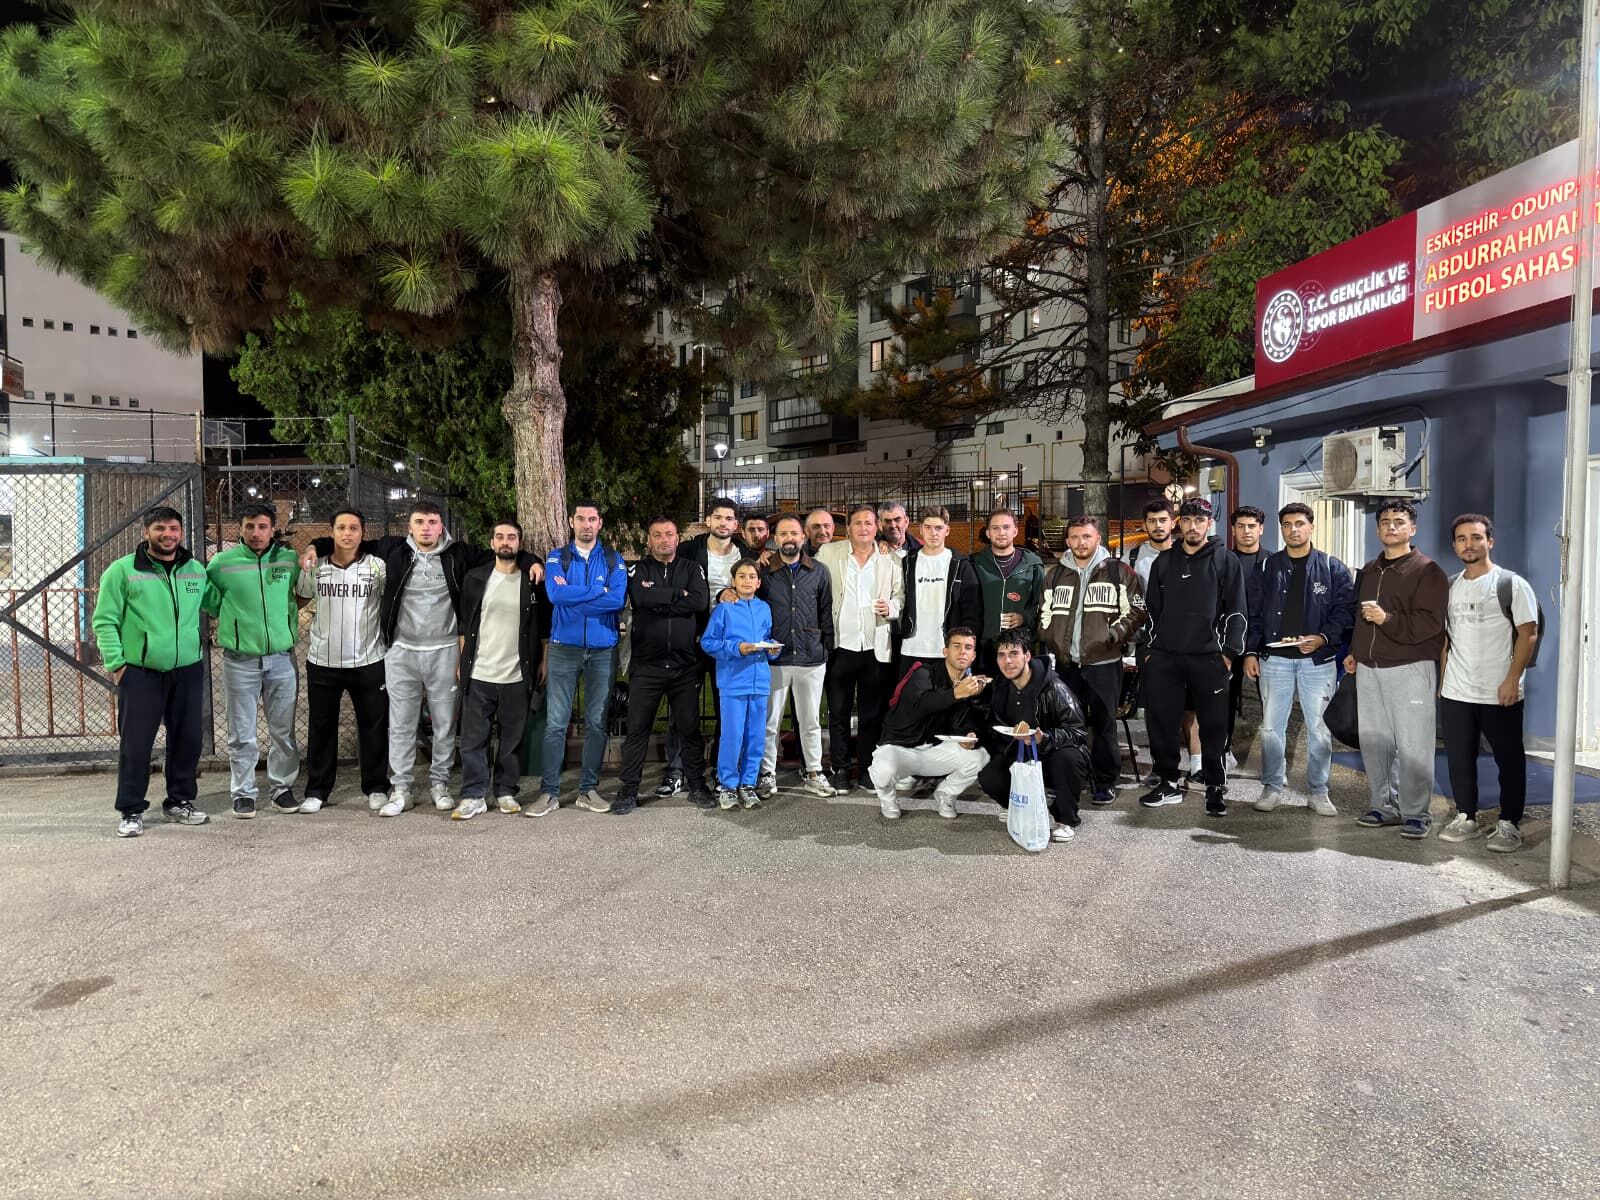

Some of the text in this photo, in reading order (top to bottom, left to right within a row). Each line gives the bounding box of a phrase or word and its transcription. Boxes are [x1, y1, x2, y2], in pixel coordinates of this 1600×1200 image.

[1426, 211, 1499, 254] ESKİŞEHİR
[1308, 294, 1328, 313] T.C.
[1330, 271, 1385, 304] GENÇLİK
[1387, 262, 1407, 284] VE
[1425, 273, 1496, 314] FUTBOL
[1501, 245, 1576, 290] SAHAS
[1307, 284, 1407, 333] SPOR BAKANLIĞI
[317, 583, 373, 598] POWER PLAY
[1087, 585, 1113, 604] SPORT
